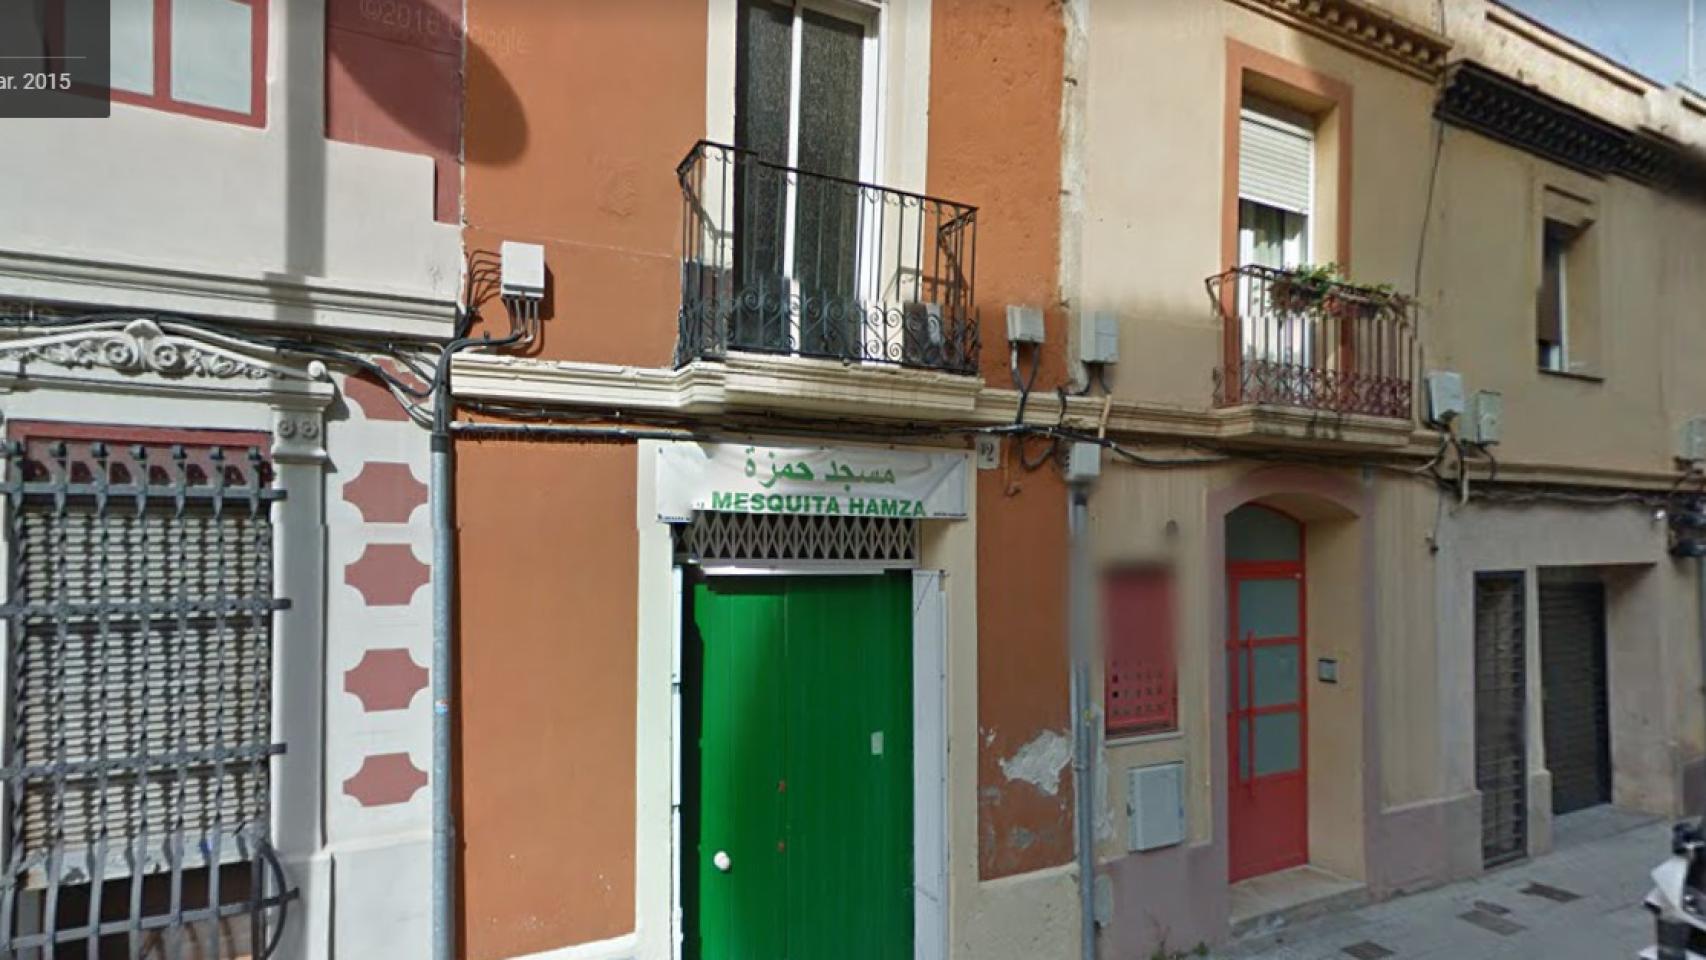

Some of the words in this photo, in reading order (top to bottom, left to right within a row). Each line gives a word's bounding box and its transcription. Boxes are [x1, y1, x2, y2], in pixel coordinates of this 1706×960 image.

[745, 447, 815, 488] حمزة
[825, 459, 896, 491] مسجد
[711, 491, 841, 514] MESQUITA
[849, 497, 927, 517] HAMZA
